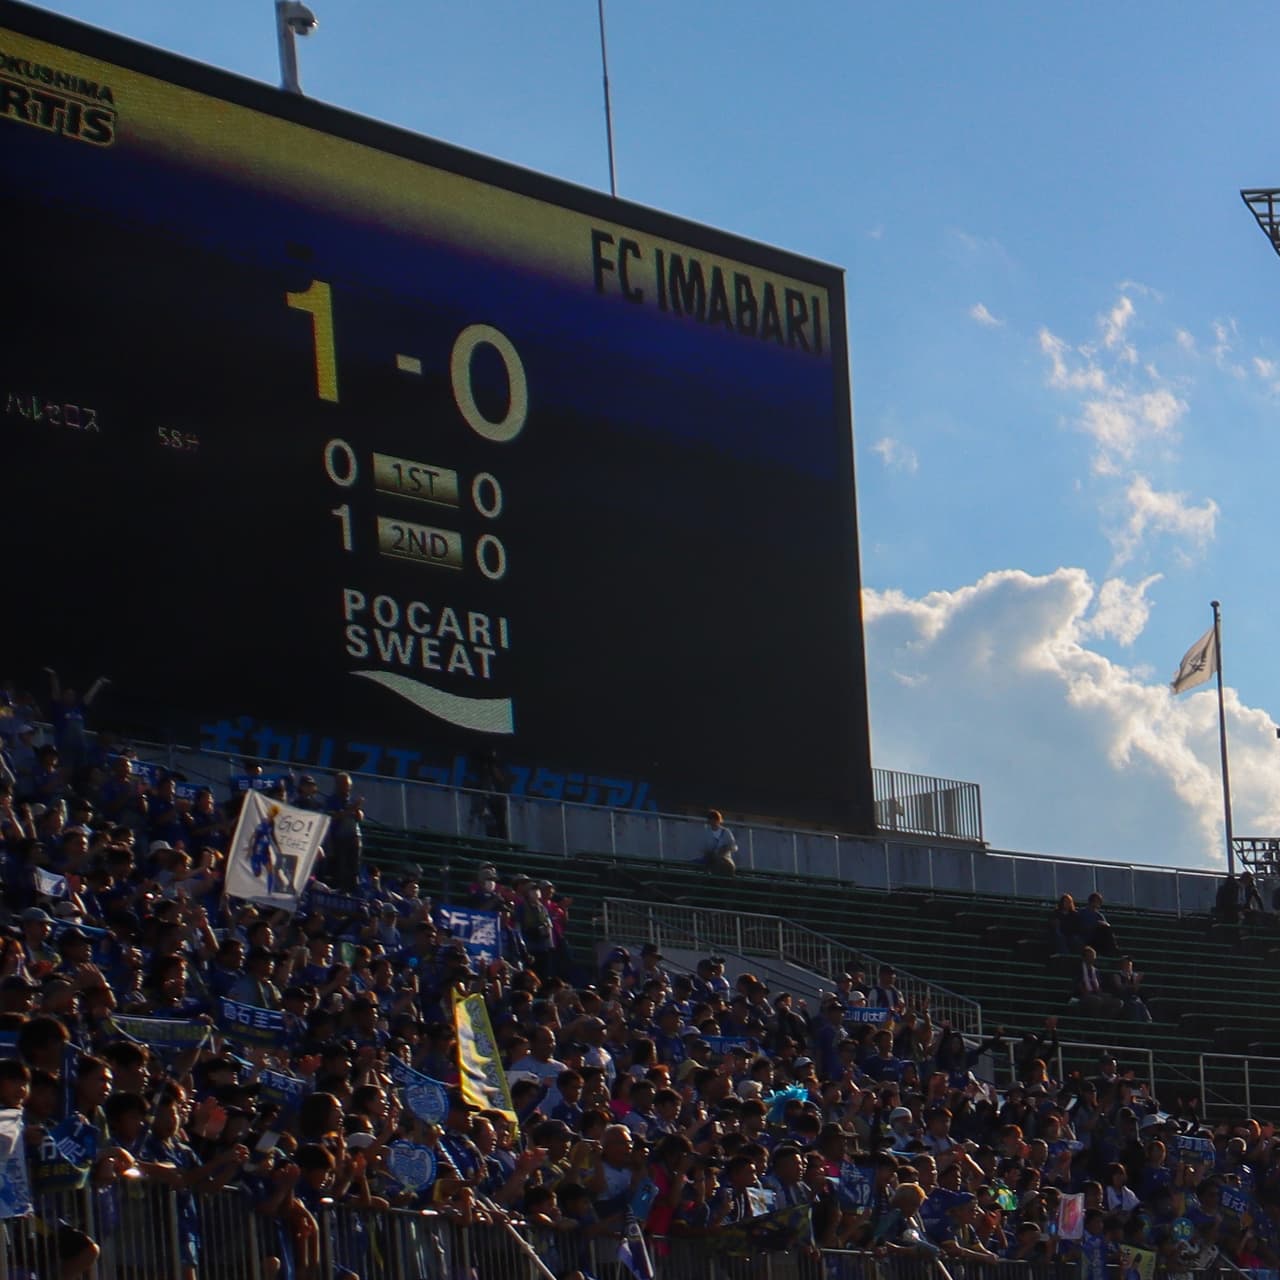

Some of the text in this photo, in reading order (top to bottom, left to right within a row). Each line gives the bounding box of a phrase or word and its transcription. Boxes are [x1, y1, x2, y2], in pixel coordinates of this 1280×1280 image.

[592, 228, 822, 354] FC IMABARI
[285, 279, 339, 403] 1
[450, 323, 528, 442] 0
[324, 438, 503, 519] 0 1ST 0
[331, 504, 507, 581] 1 2ND 0
[343, 588, 510, 649] POCARI
[345, 624, 497, 680] SWEAT
